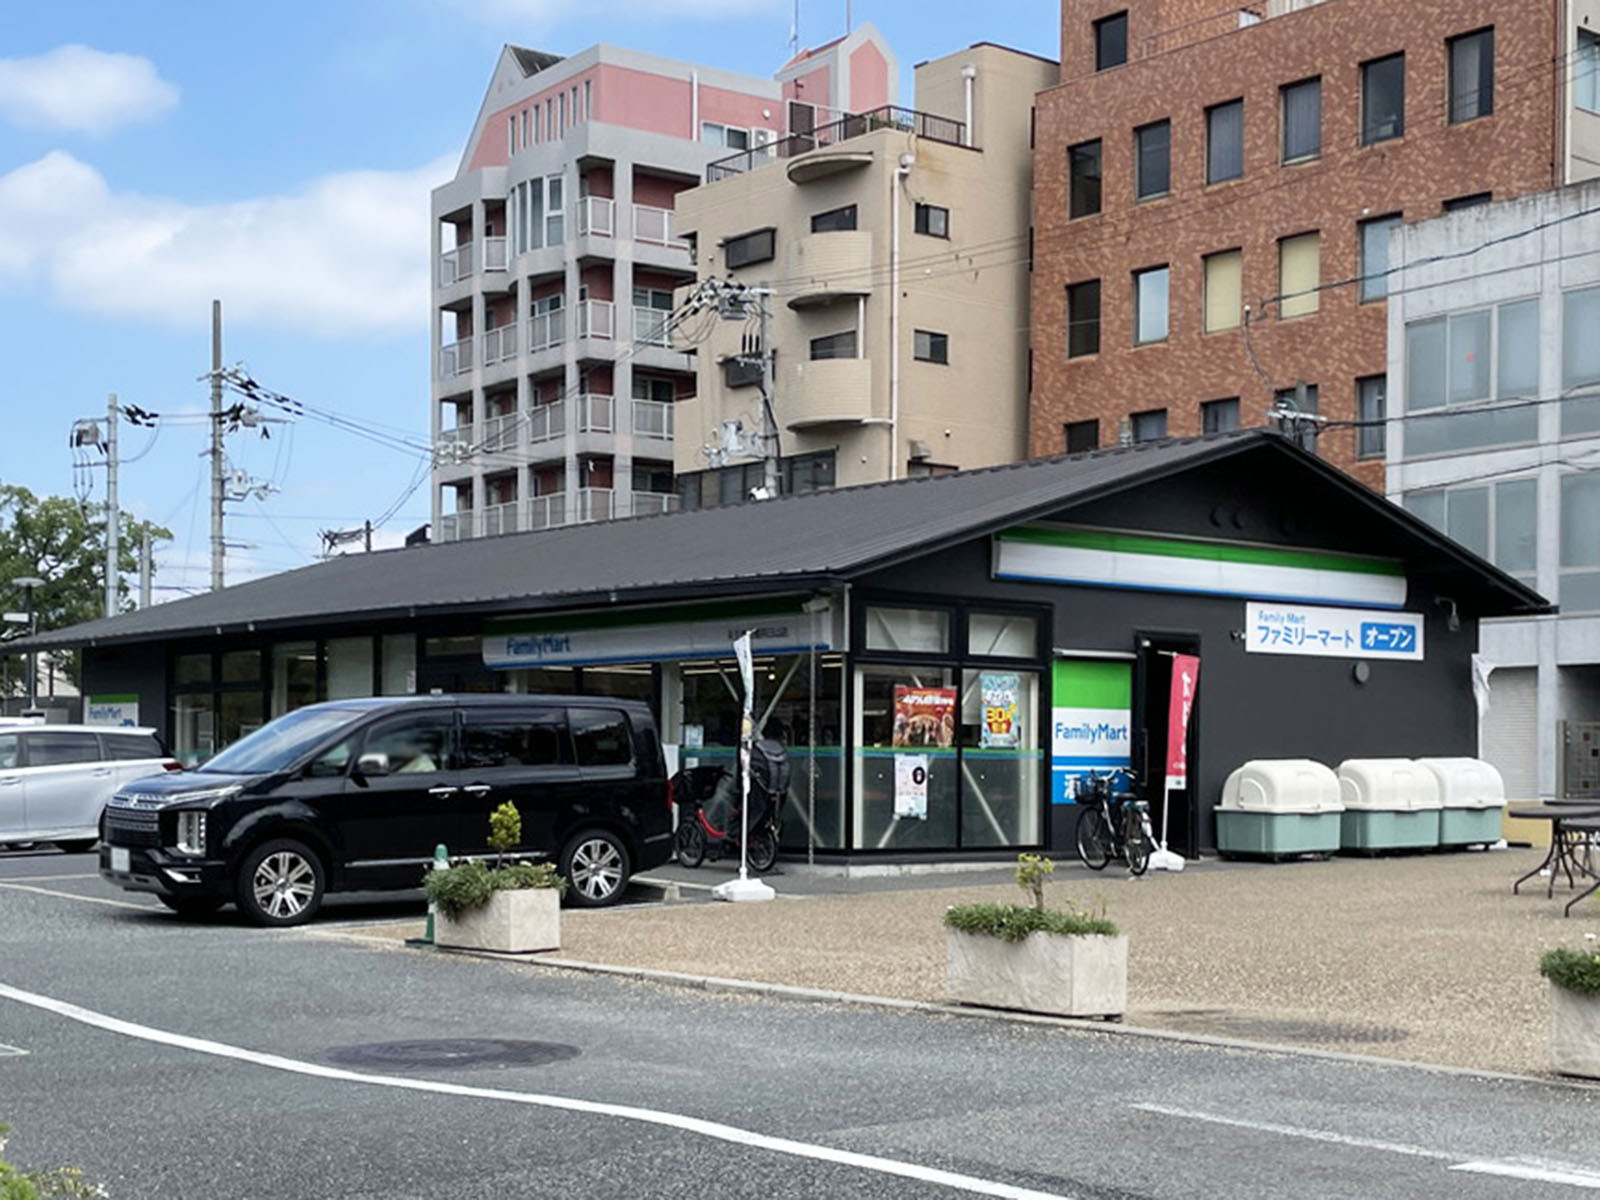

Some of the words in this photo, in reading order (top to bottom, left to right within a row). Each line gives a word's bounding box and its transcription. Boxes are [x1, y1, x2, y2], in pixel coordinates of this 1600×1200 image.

[1258, 610, 1285, 625] Family
[1287, 612, 1305, 623] Mart
[506, 634, 571, 659] FamilyMart
[1257, 626, 1354, 649] ファミリーマート
[1366, 626, 1413, 649] オープン
[1055, 723, 1128, 743] FamilyMart
